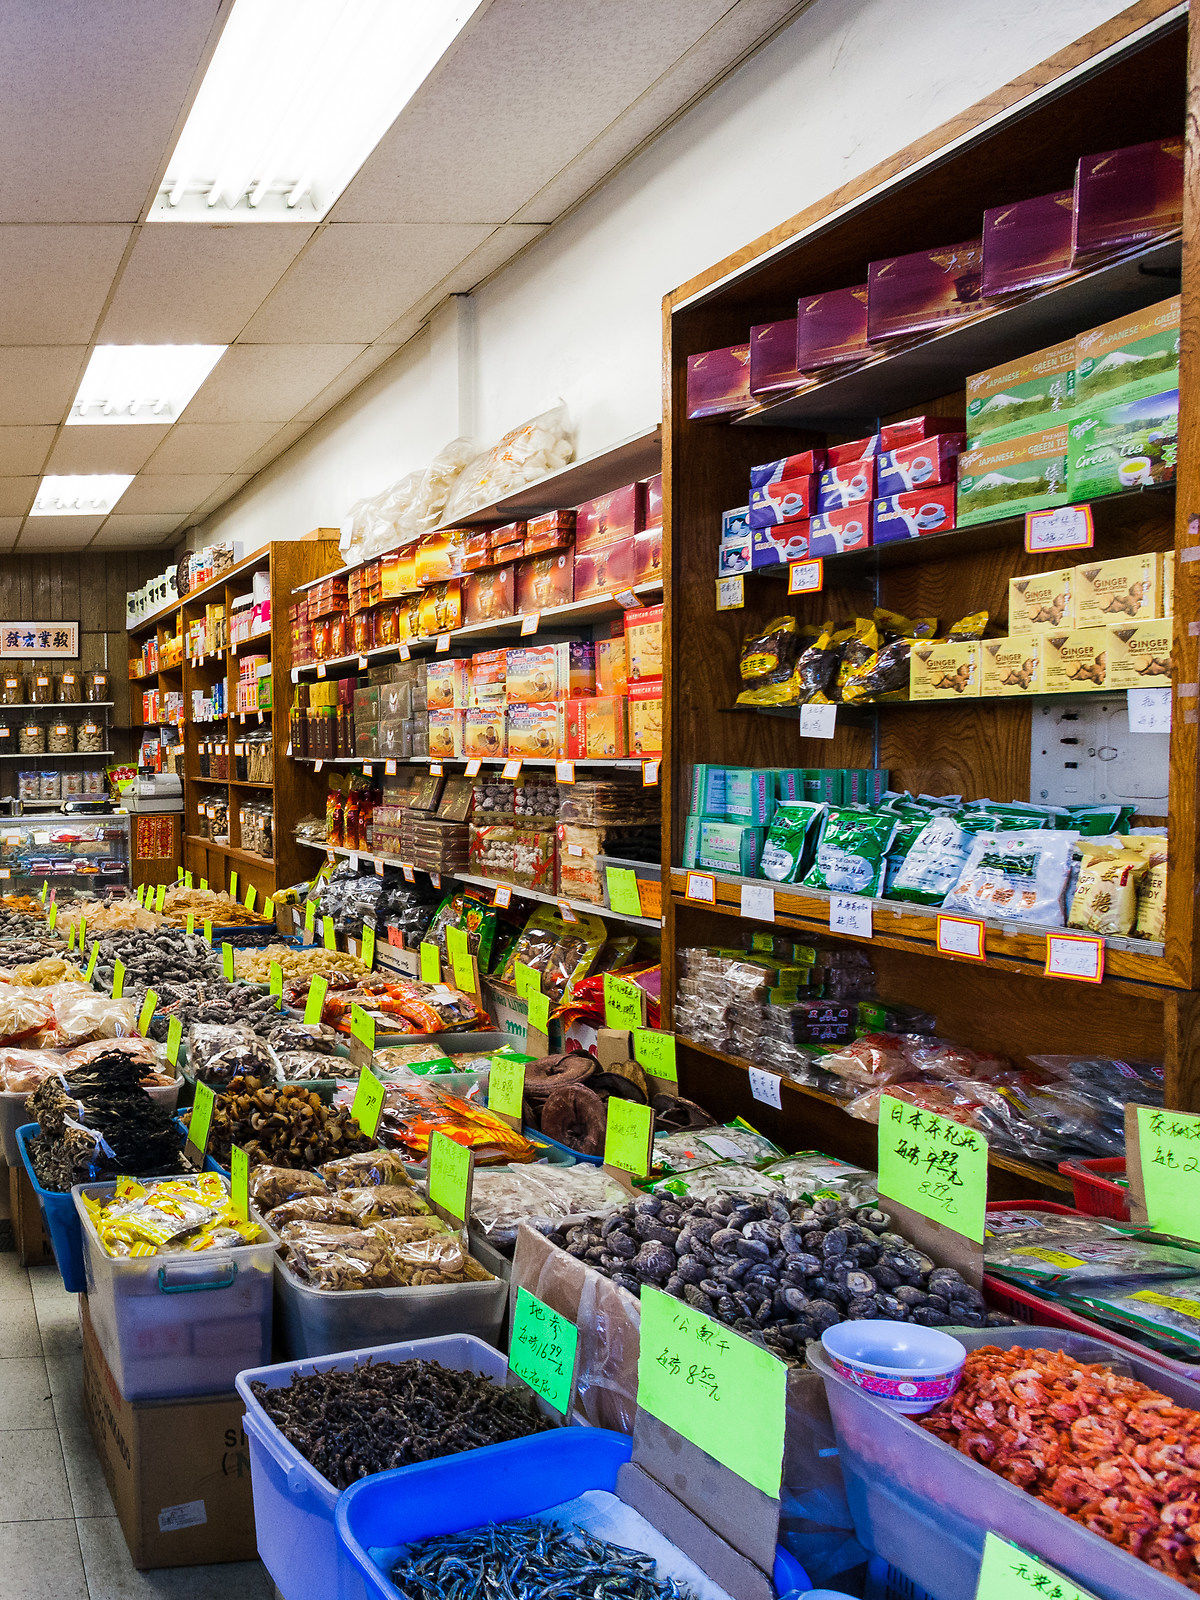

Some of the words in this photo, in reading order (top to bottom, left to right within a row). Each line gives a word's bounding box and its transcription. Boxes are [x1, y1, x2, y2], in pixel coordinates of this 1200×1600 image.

[1099, 324, 1139, 347] JAPANESE
[986, 371, 1020, 389] JAPANESE
[1032, 357, 1058, 373] GREEN
[1059, 352, 1075, 364] TEA
[978, 450, 1015, 467] JAPANESE
[1028, 441, 1054, 455] GREEN
[1075, 452, 1114, 469] Green
[1120, 444, 1144, 458] Tea
[1094, 577, 1128, 588] GINGER
[1025, 590, 1051, 600] GINGER
[1128, 639, 1168, 649] GINGER
[1061, 647, 1094, 656] GINGER
[927, 659, 956, 667] GINGER
[995, 653, 1022, 662] GINGER
[742, 659, 767, 672] 五花茶
